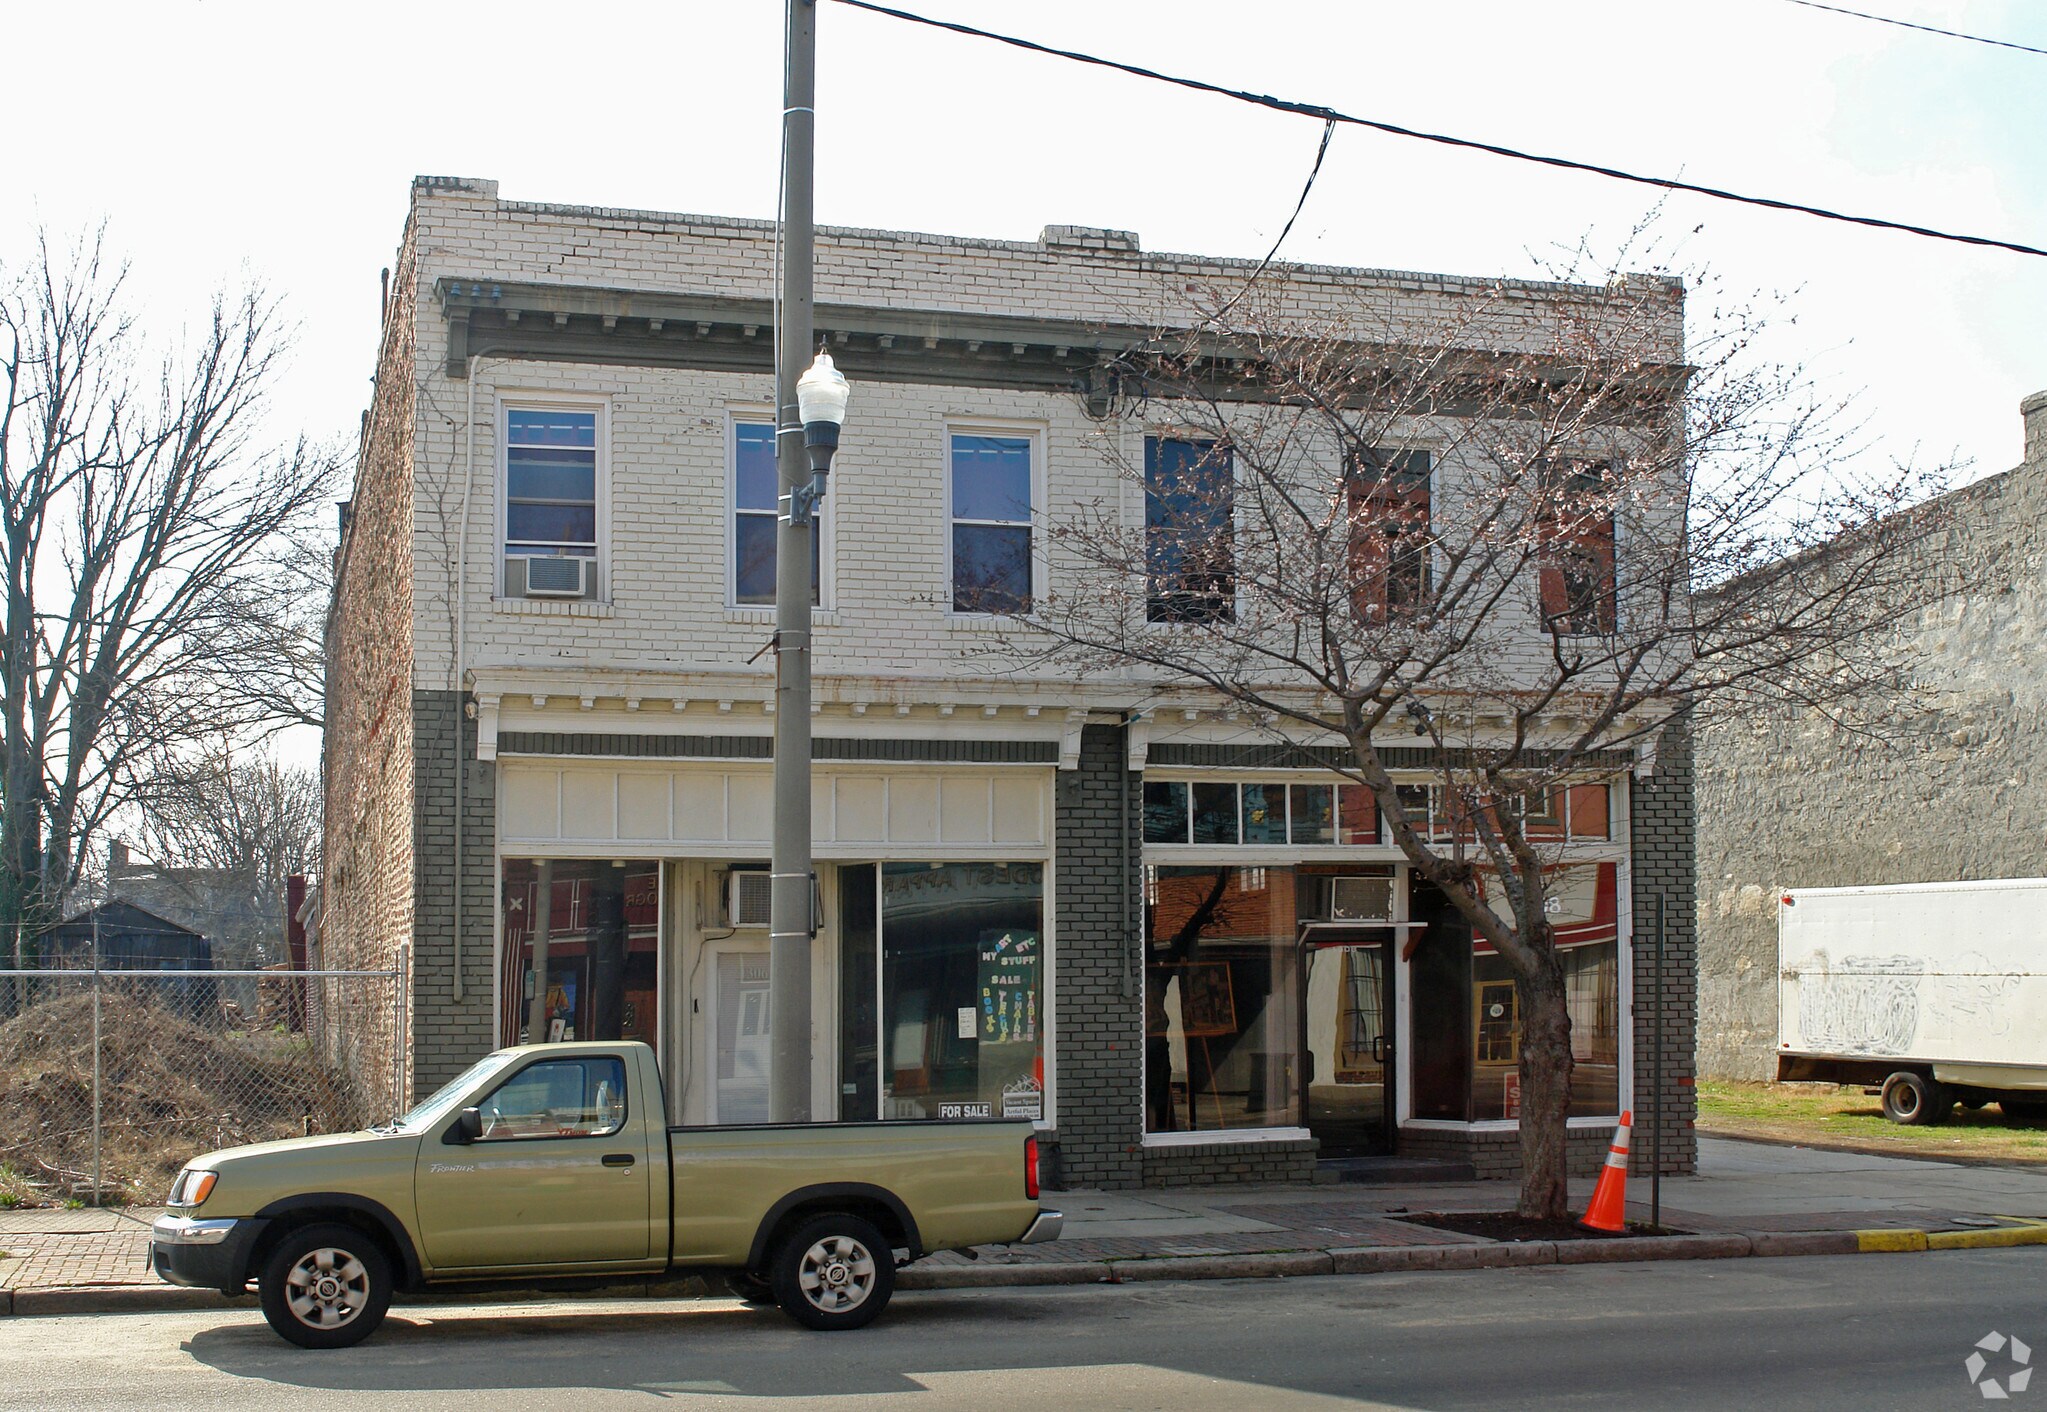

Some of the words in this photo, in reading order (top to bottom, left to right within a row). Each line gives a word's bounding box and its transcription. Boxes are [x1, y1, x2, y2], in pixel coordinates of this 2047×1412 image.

[982, 952, 998, 961] MY
[1001, 956, 1036, 966] STUFF
[991, 975, 1021, 985] SALE
[941, 1105, 961, 1118] FOR
[963, 1105, 989, 1118] SALE
